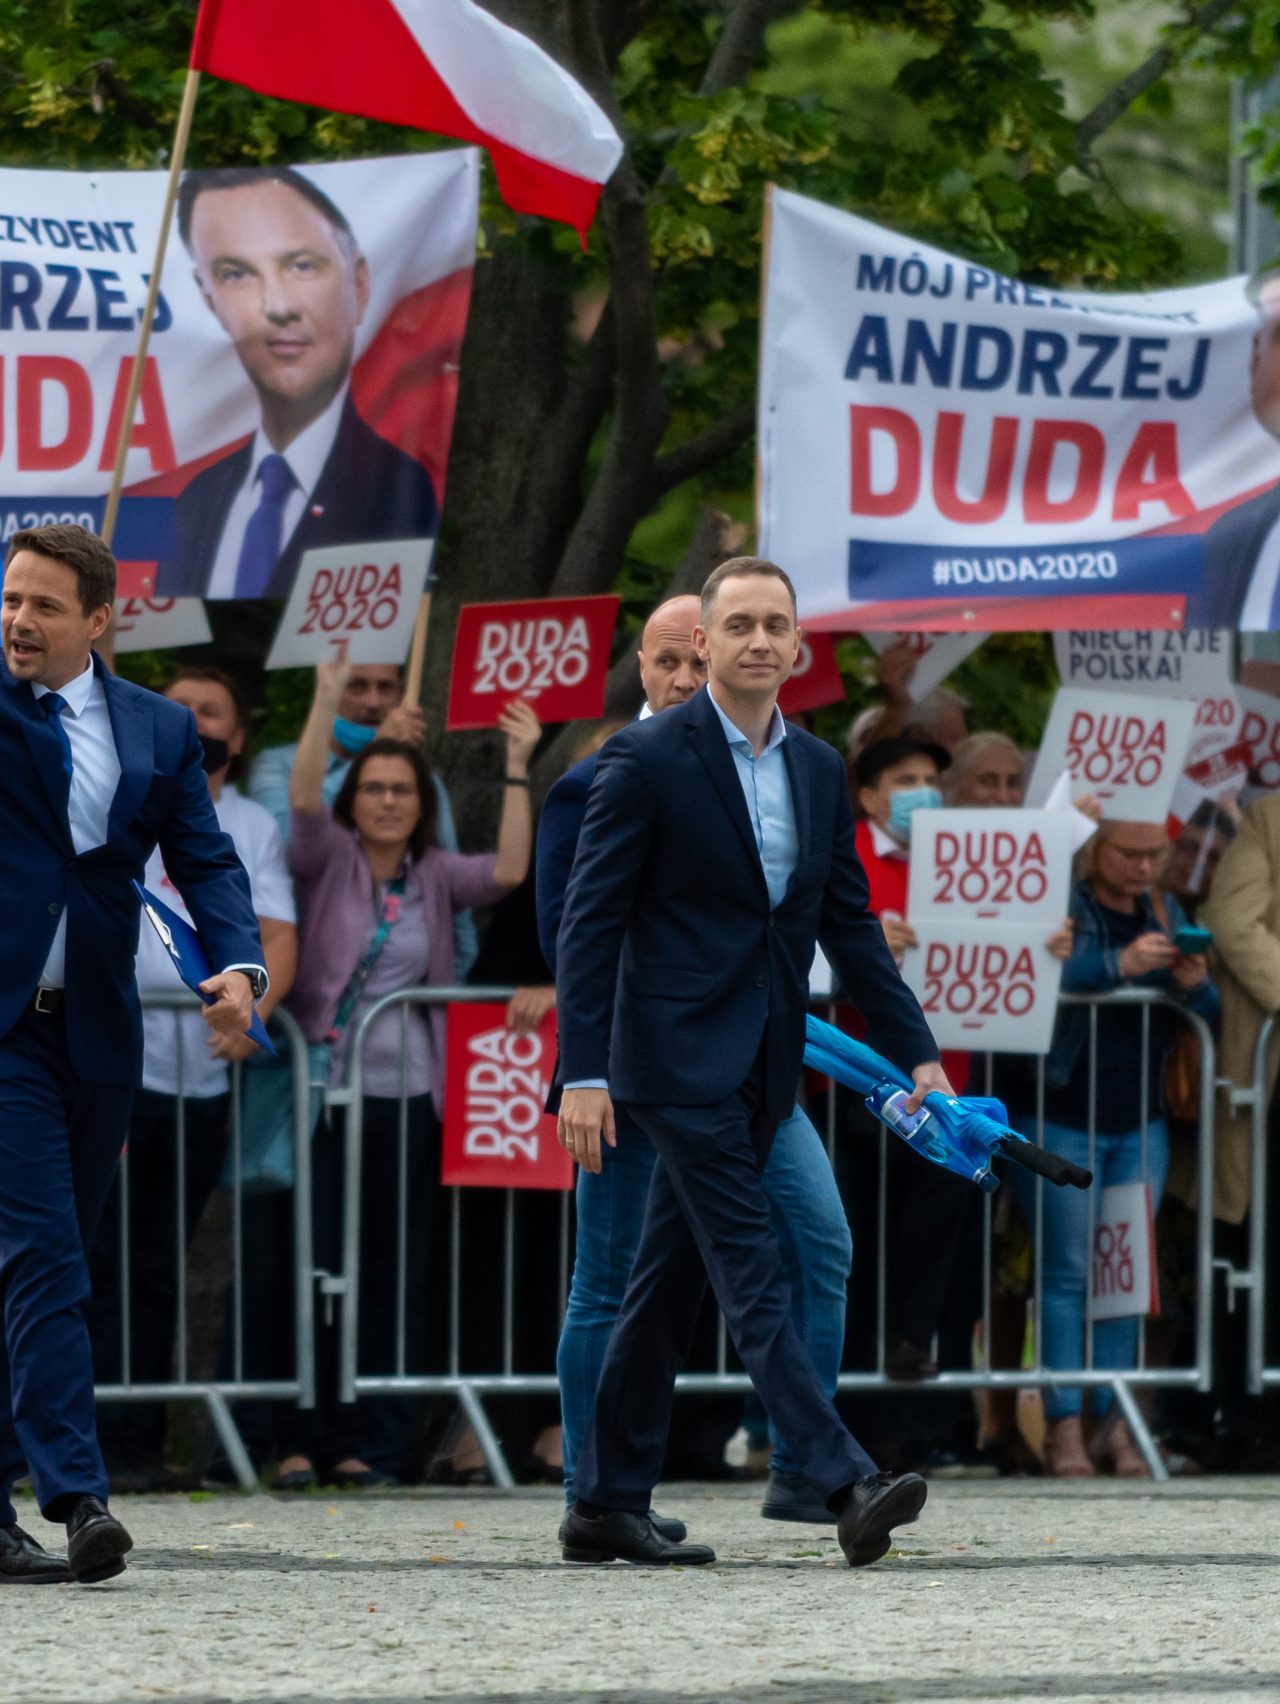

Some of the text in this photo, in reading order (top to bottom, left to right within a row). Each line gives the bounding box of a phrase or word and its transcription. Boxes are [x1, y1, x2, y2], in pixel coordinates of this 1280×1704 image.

[855, 252, 954, 297] MÓJ
[843, 314, 1212, 401] ANDRZEJ
[849, 404, 1198, 526] DUDA
[309, 564, 402, 601] DUDA
[933, 551, 1118, 587] #DUDA2020
[297, 597, 399, 634] 2020
[481, 617, 590, 657] DUDA
[472, 650, 589, 693] 2020
[1070, 654, 1181, 681] POLSKA!
[1067, 711, 1167, 753] DUDA
[1066, 750, 1162, 787] 2020
[934, 832, 1047, 868] DUDA
[933, 867, 1047, 903] 2020
[926, 943, 1036, 981] DUDA
[922, 979, 1036, 1016] 2020
[465, 1029, 507, 1155] DUDA
